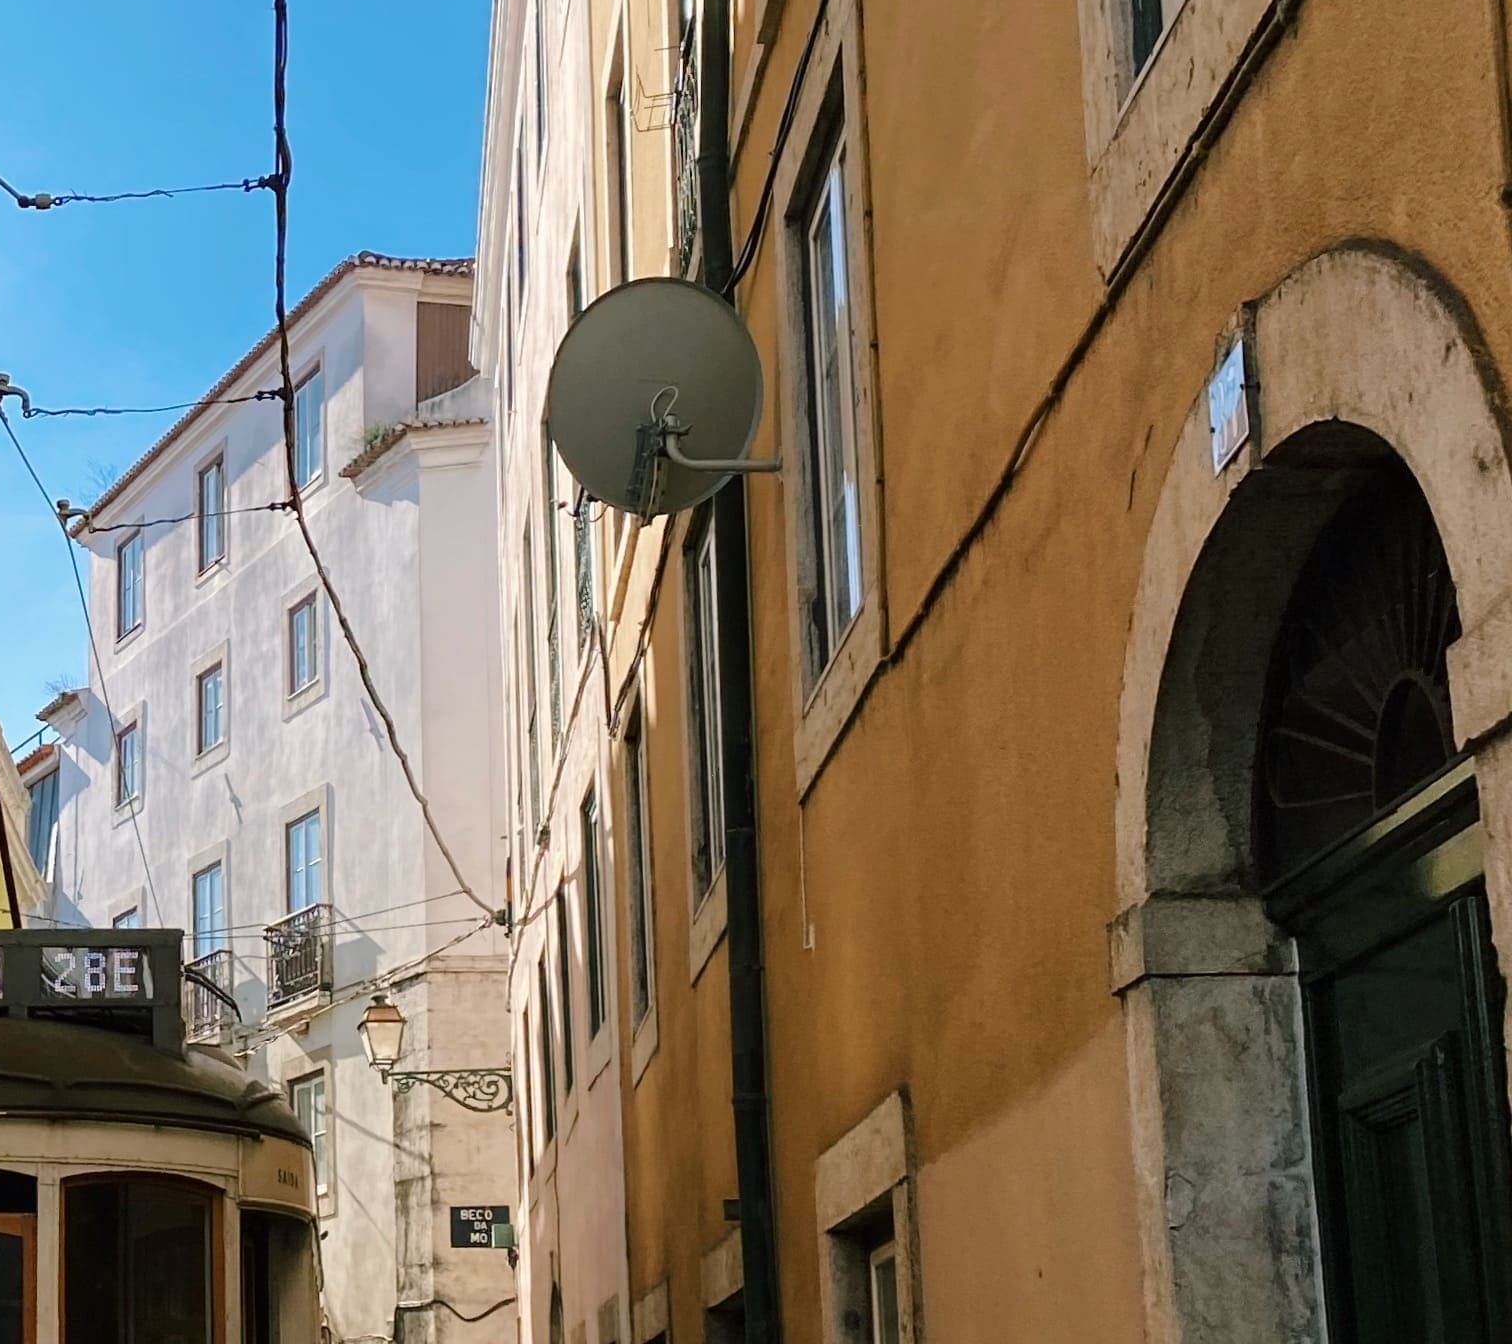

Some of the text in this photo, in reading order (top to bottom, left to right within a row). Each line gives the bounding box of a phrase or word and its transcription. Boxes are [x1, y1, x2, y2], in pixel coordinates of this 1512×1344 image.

[54, 951, 139, 993] 28E
[460, 1209, 493, 1221] BECO
[474, 1221, 488, 1230] DA
